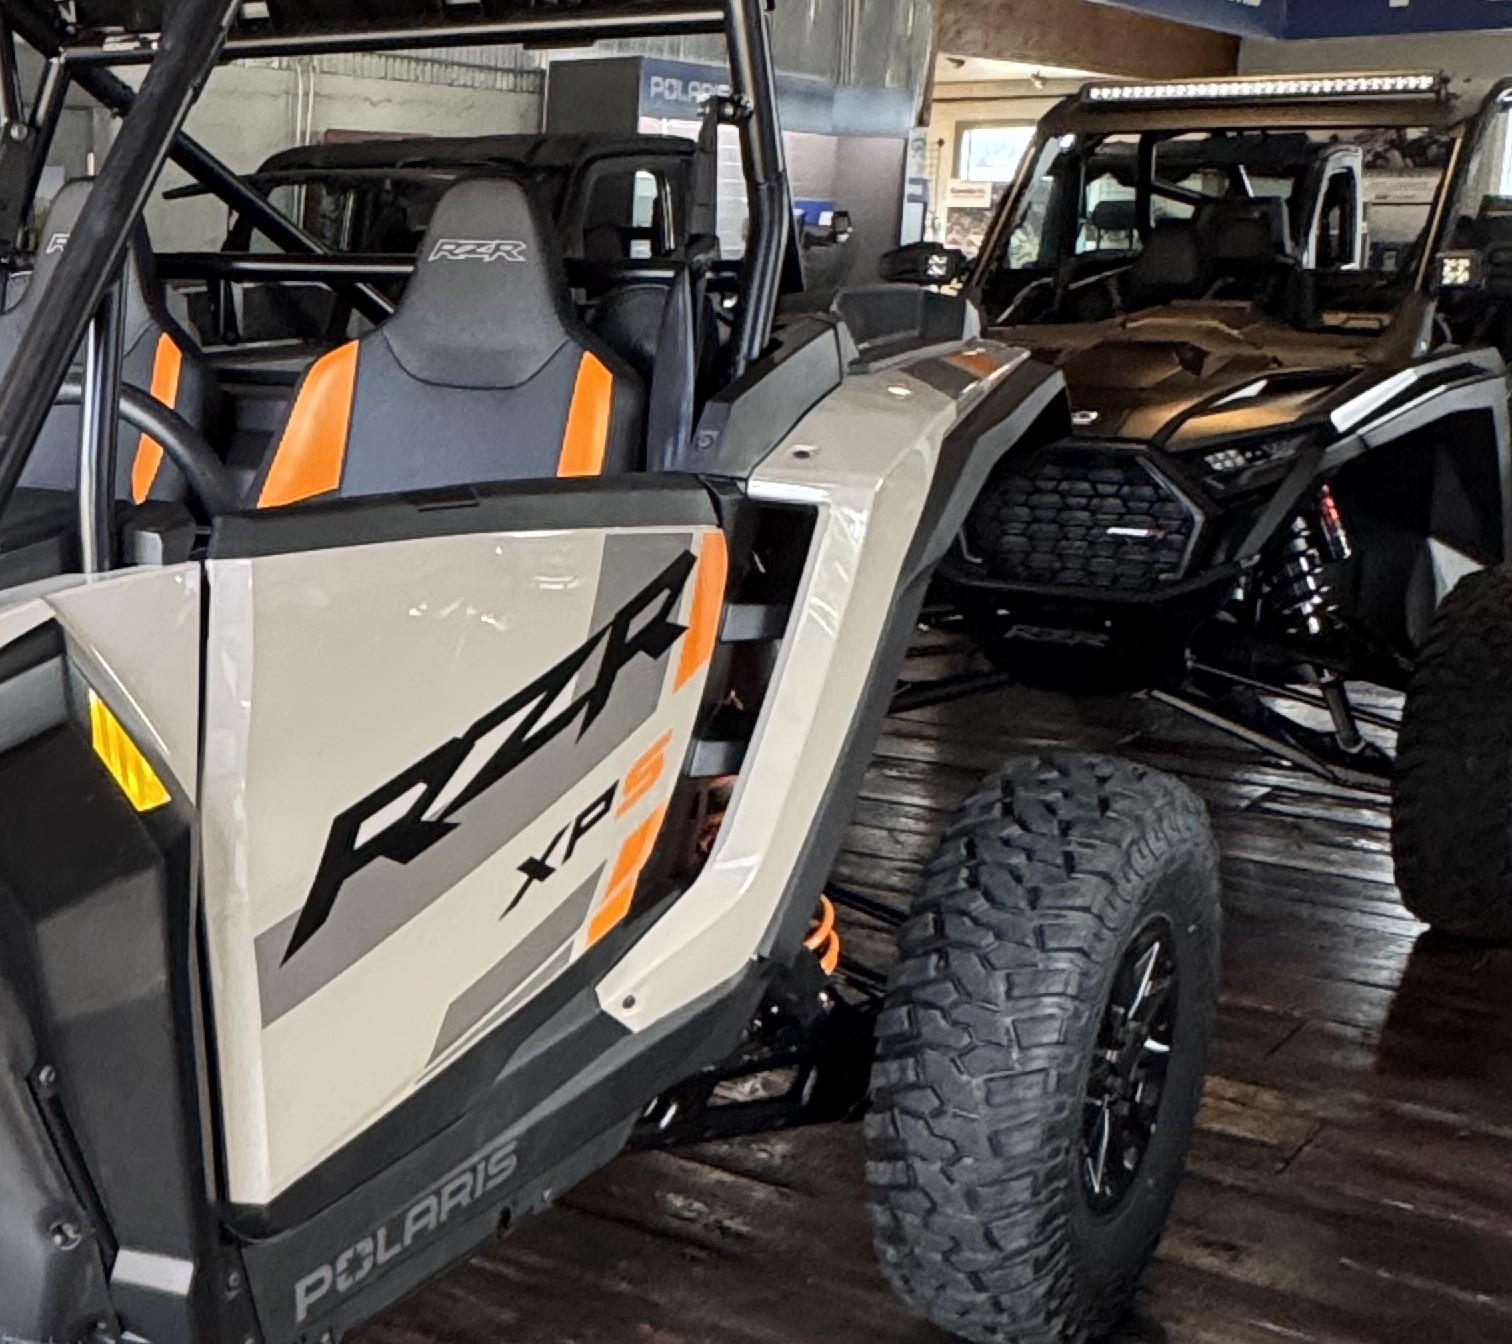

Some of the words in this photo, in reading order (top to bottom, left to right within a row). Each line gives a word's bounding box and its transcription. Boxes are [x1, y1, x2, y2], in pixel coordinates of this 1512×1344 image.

[428, 238, 527, 262] RZR
[279, 549, 698, 968] RZR
[294, 1139, 518, 1324] POLARIS
